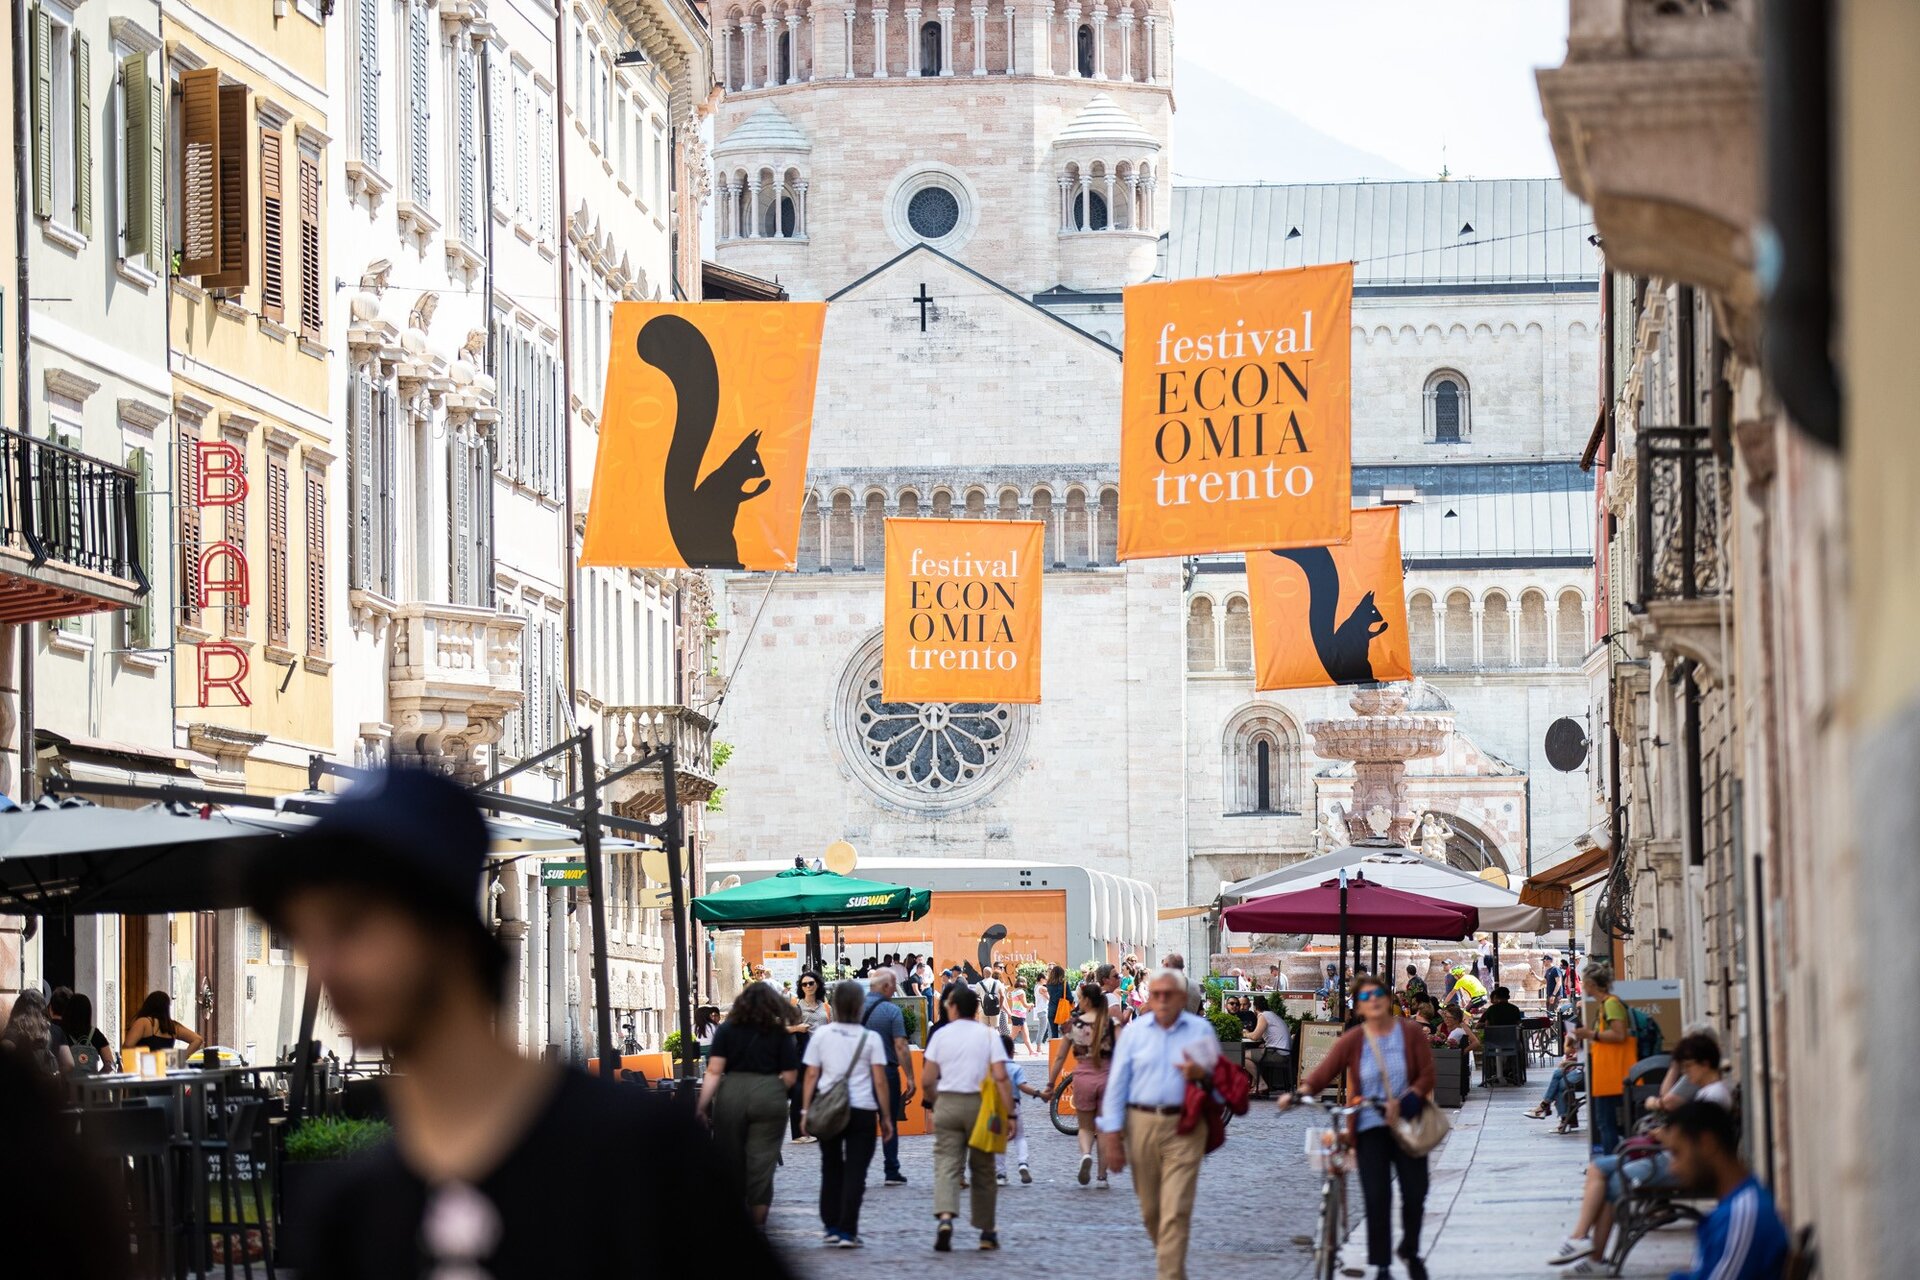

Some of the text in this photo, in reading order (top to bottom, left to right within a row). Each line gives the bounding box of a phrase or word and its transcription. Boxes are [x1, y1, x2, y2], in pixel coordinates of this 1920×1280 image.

[1155, 310, 1314, 366] festival
[1154, 358, 1313, 415] ECON
[1154, 409, 1312, 464] OMIA
[1152, 460, 1314, 507] trento
[197, 441, 252, 708] BAR
[908, 548, 1019, 577] festival
[909, 581, 1018, 610] ECON
[909, 613, 1016, 643] OMIA
[908, 645, 1018, 671] trento
[544, 869, 587, 880] SUBWAY
[846, 893, 896, 908] SUBWAY
[993, 950, 1037, 962] festival
